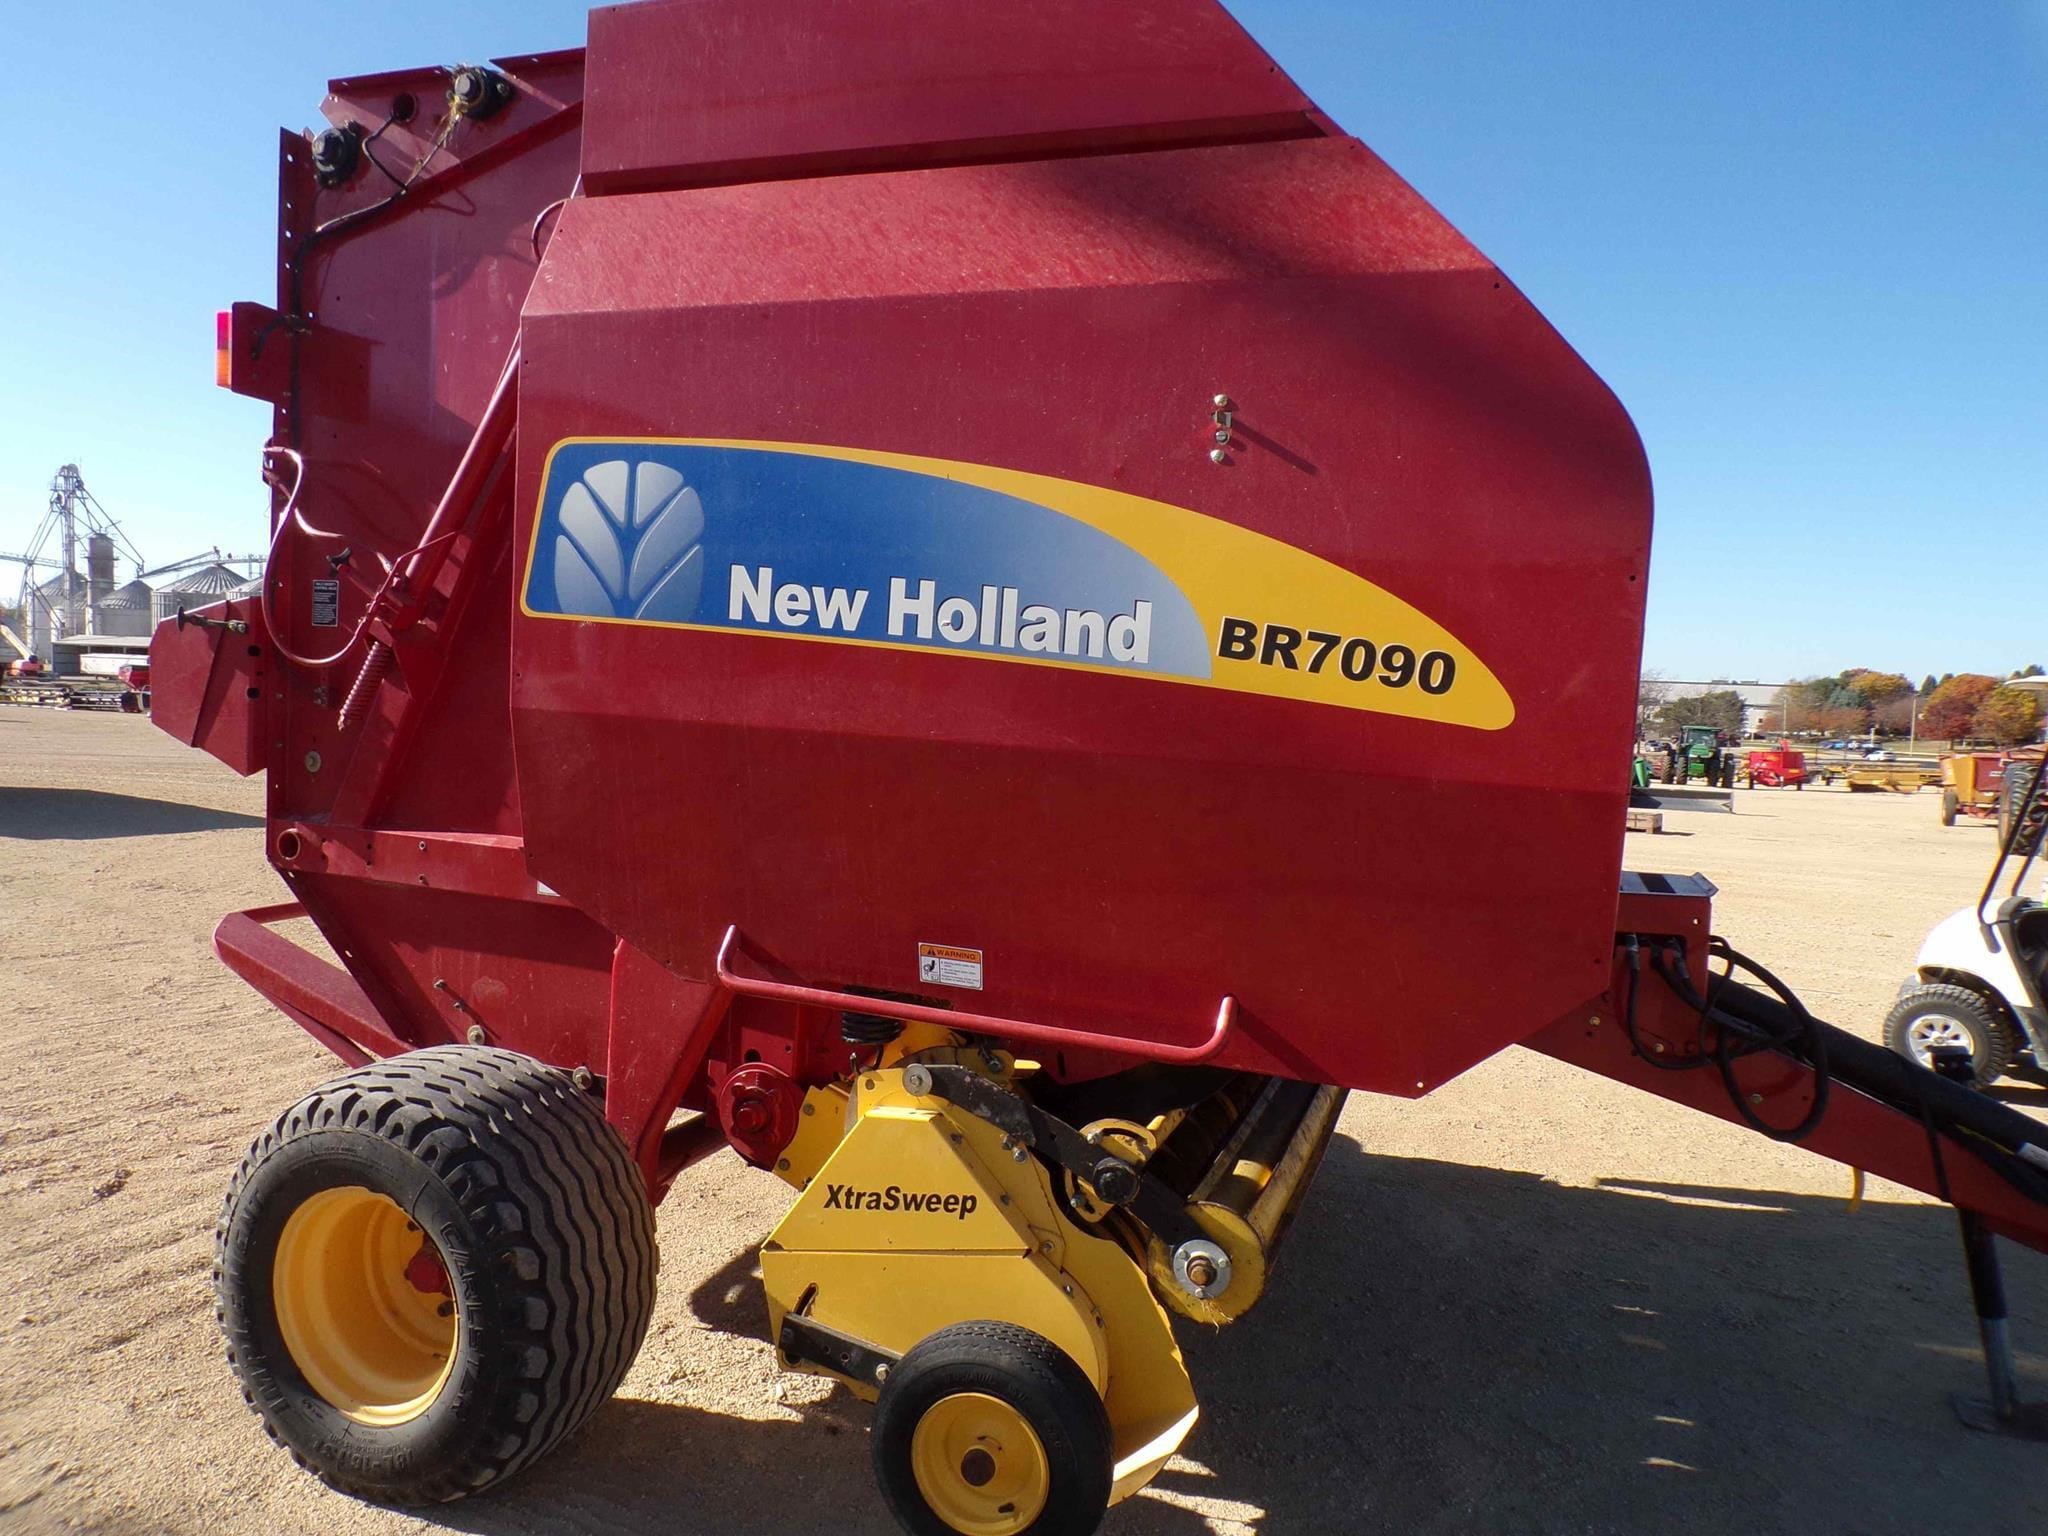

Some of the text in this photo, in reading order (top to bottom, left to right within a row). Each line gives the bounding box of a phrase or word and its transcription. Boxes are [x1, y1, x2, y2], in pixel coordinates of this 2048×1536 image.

[728, 564, 1153, 664] New Holland
[1217, 616, 1456, 695] BR7090
[937, 950, 976, 960] WARNING
[823, 1184, 977, 1220] XtraSweep
